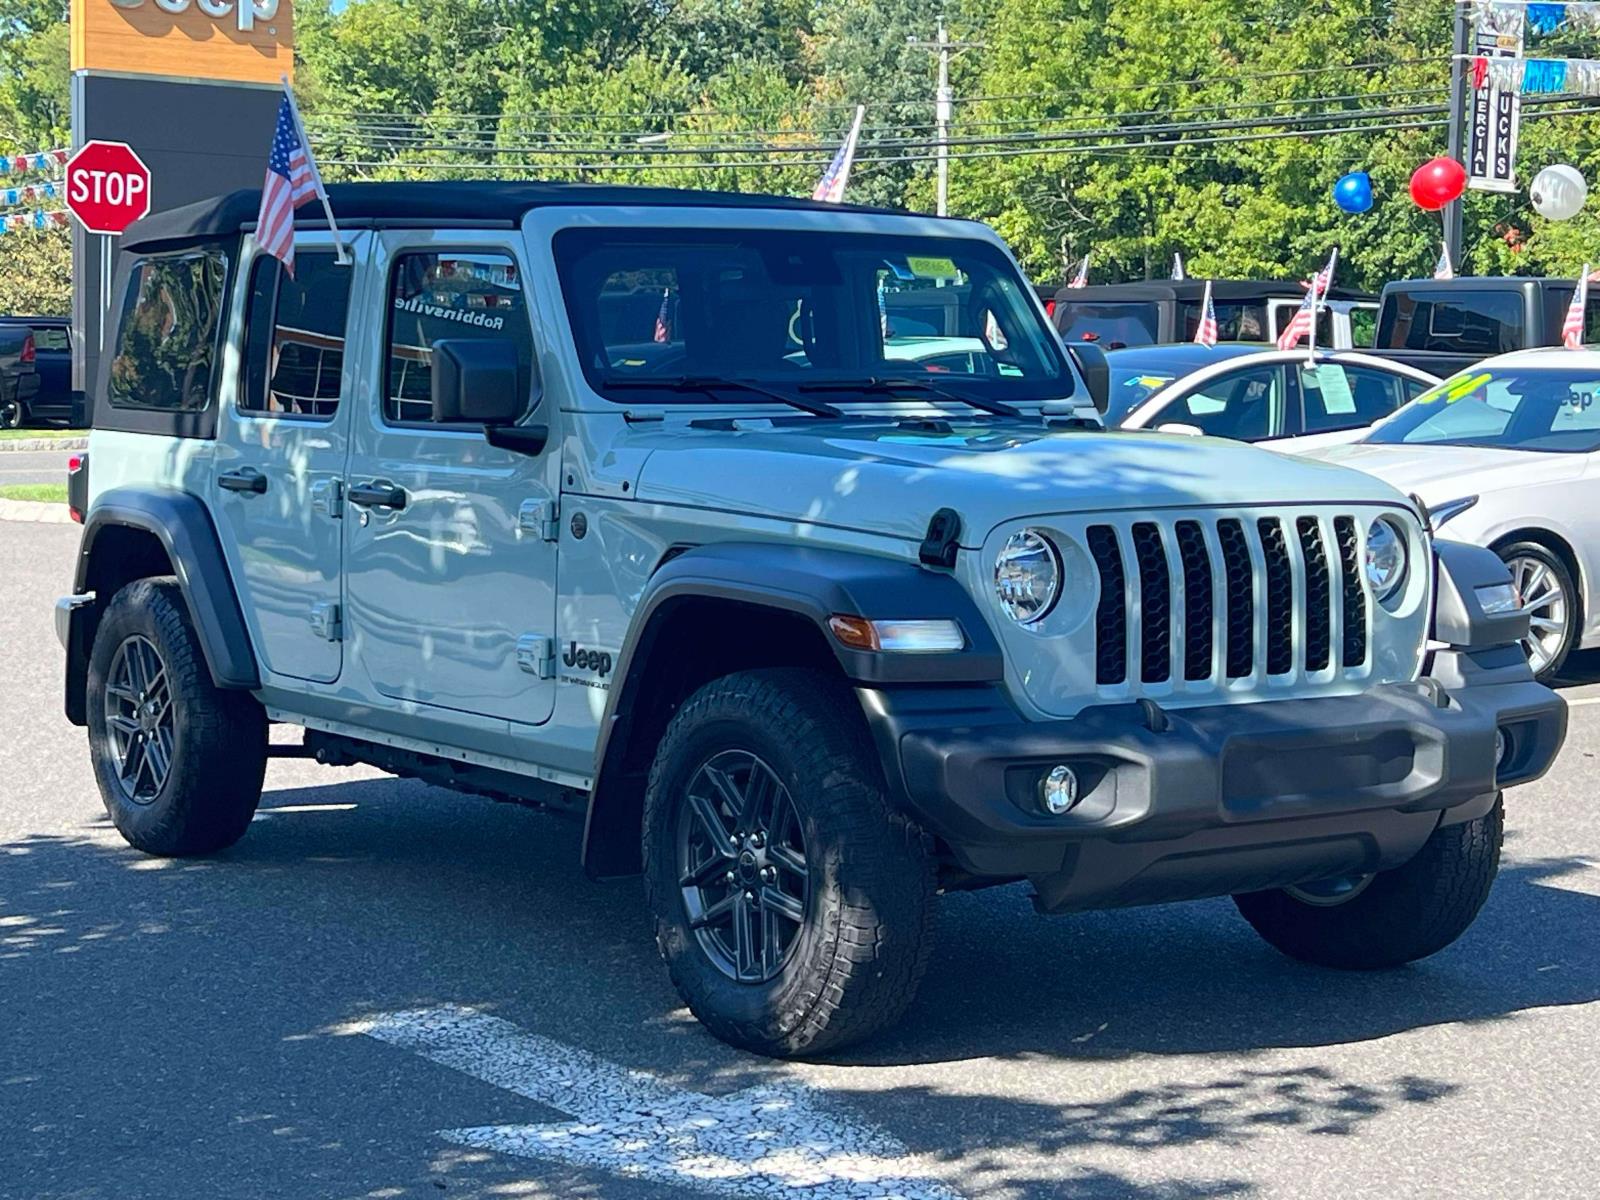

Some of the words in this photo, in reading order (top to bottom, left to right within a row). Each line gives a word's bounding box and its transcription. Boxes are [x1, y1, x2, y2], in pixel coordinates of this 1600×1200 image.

[1497, 95, 1510, 175] UCKS
[71, 168, 145, 207] STOP
[562, 640, 612, 678] Jeep
